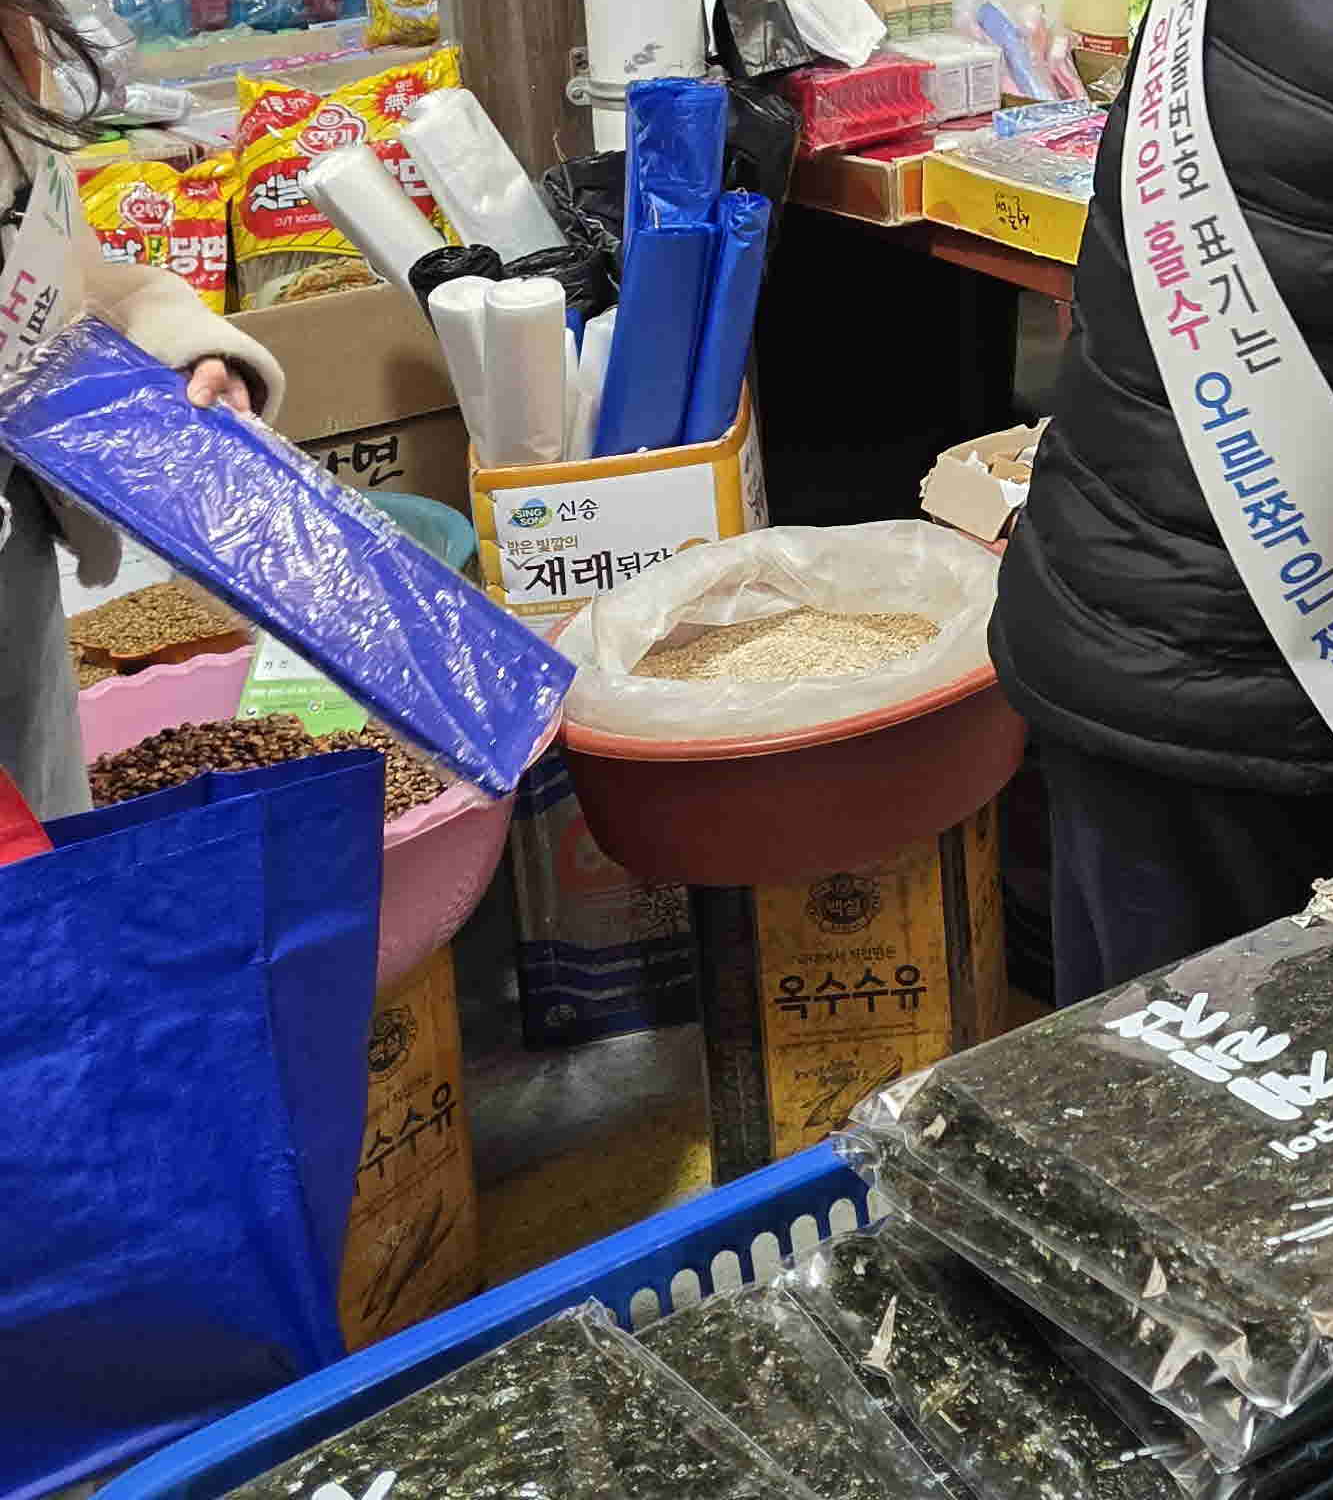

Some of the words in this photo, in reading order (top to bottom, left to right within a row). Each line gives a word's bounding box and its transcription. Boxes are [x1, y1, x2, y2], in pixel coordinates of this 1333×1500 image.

[1143, 219, 1210, 351] 홀수
[1190, 213, 1283, 374] 표기는
[556, 498, 600, 523] 신송
[774, 964, 929, 1020] 옥수수유
[354, 1081, 458, 1192] 수수유
